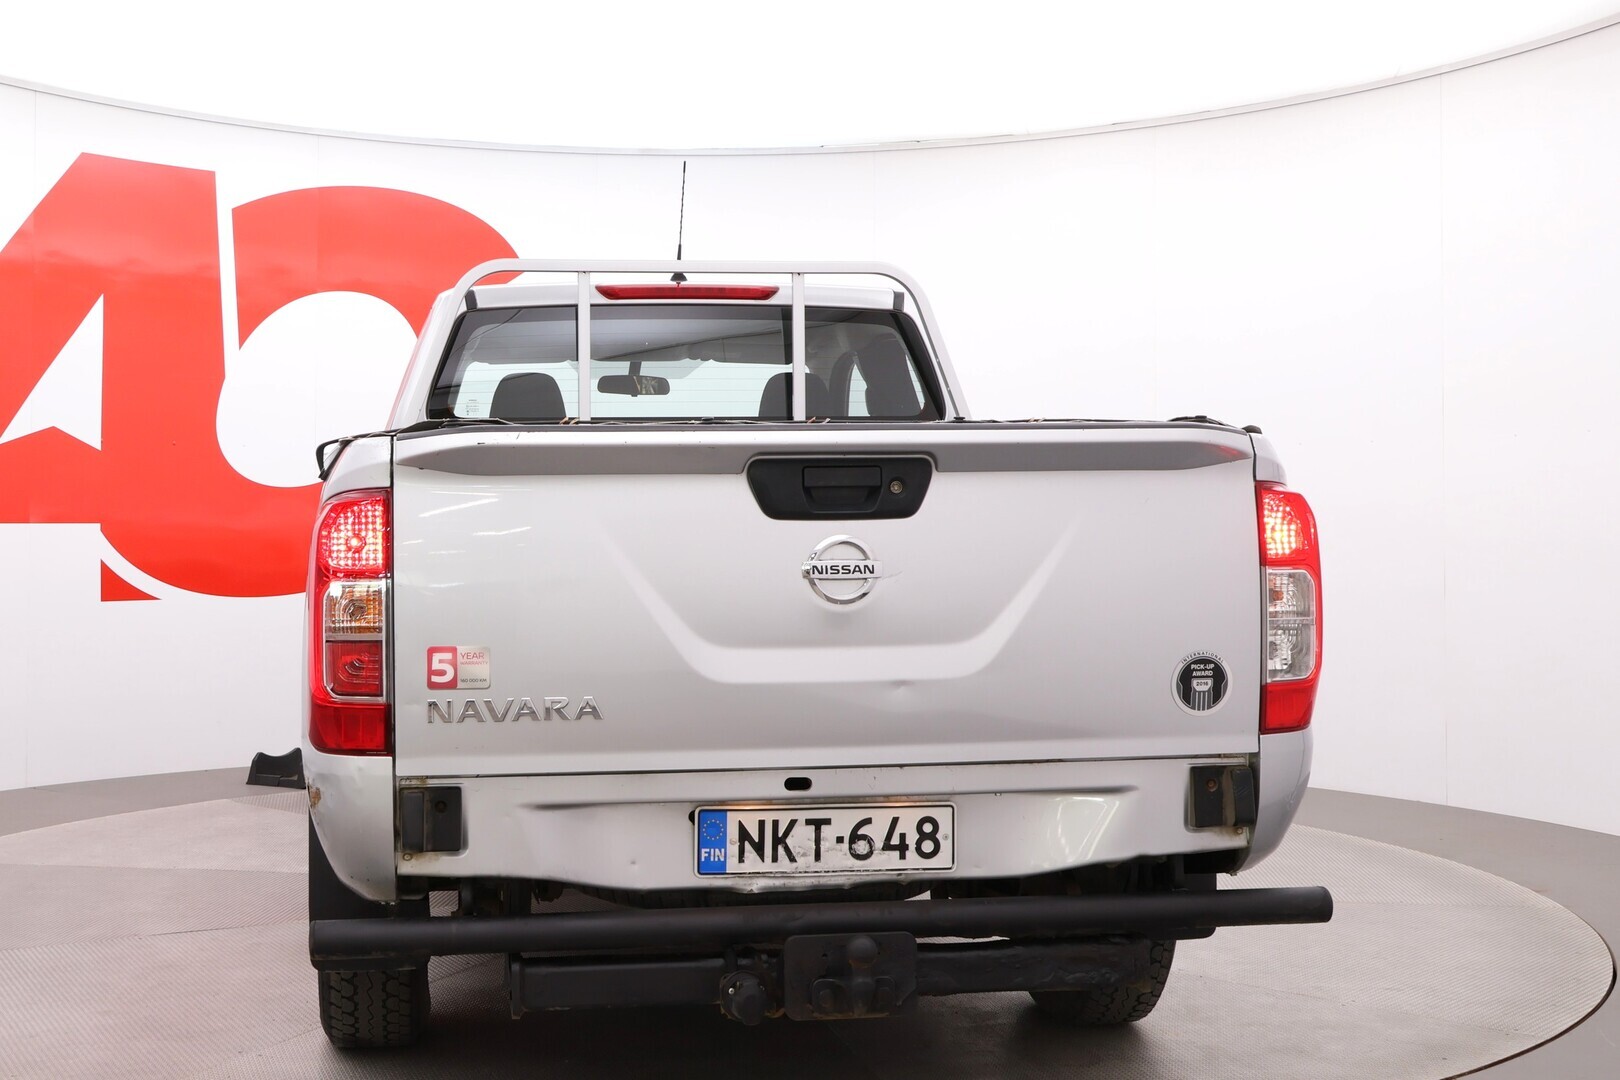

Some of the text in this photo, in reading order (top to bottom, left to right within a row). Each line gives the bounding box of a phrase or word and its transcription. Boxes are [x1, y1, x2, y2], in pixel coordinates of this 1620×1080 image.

[811, 564, 875, 575] NISSAN
[460, 651, 485, 660] YEAR
[1180, 651, 1225, 665] INTERNATIONAL
[430, 652, 455, 684] 5
[427, 696, 604, 723] NAVARA
[738, 815, 941, 864] NKT-648
[701, 847, 725, 862] FIN
